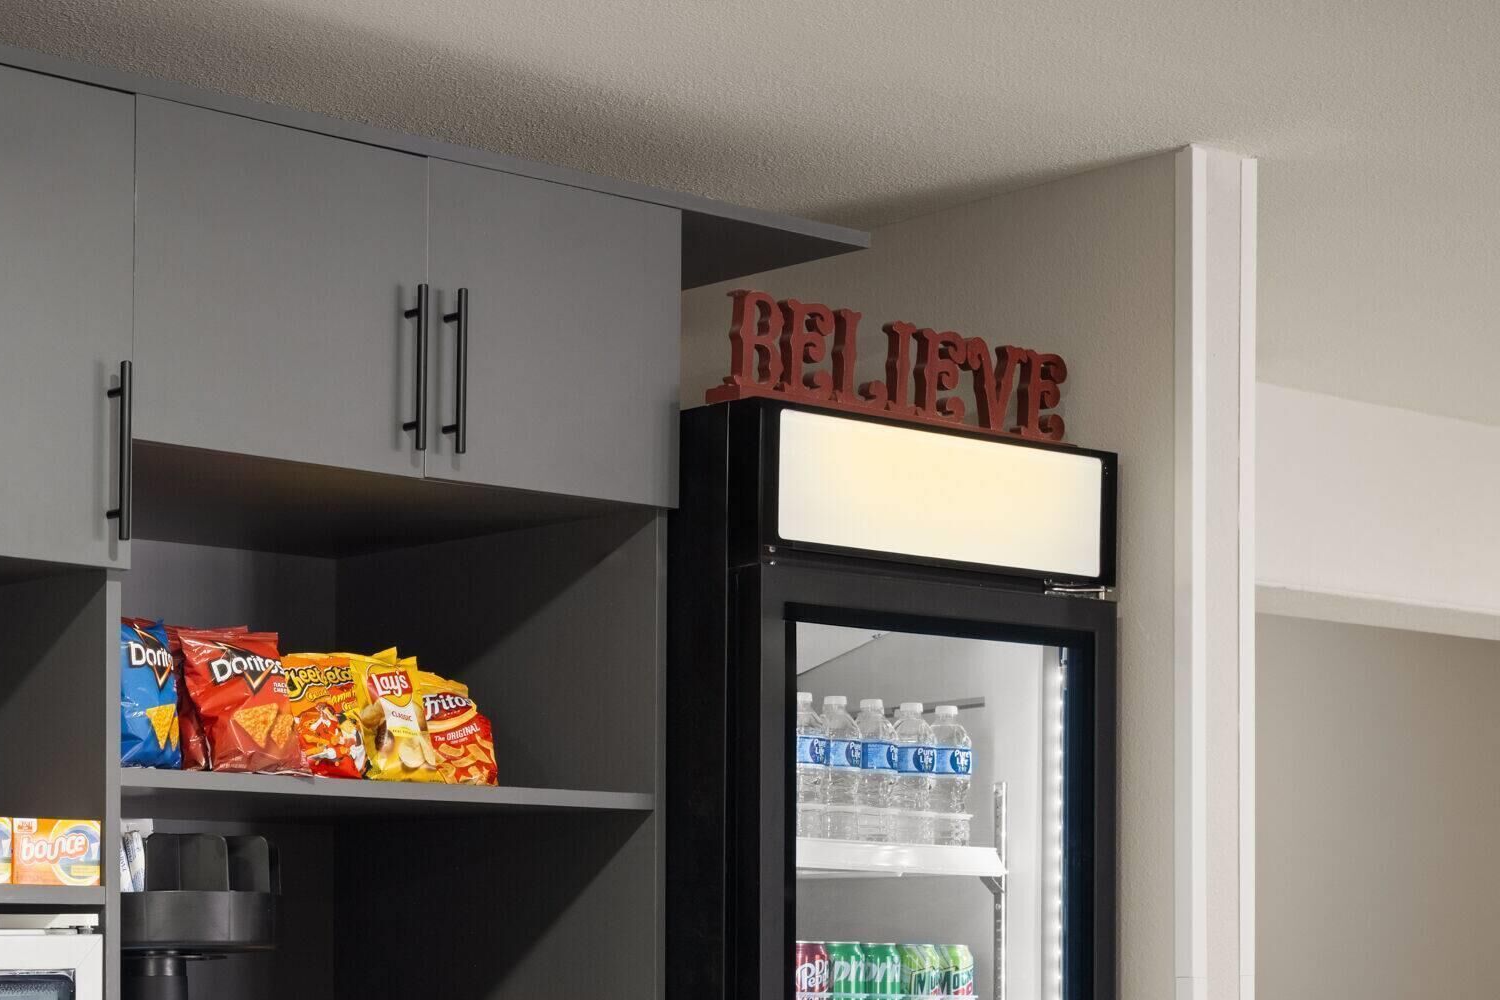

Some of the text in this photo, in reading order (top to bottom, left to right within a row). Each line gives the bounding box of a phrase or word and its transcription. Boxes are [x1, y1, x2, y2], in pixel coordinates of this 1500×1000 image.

[727, 289, 1068, 442] BELIEVE
[211, 655, 285, 683] Doritos
[371, 671, 409, 697] Lay's
[391, 710, 413, 722] CLASSIC
[446, 722, 481, 741] ORIGINAL
[917, 747, 934, 756] Pure
[20, 832, 88, 861] bounce
